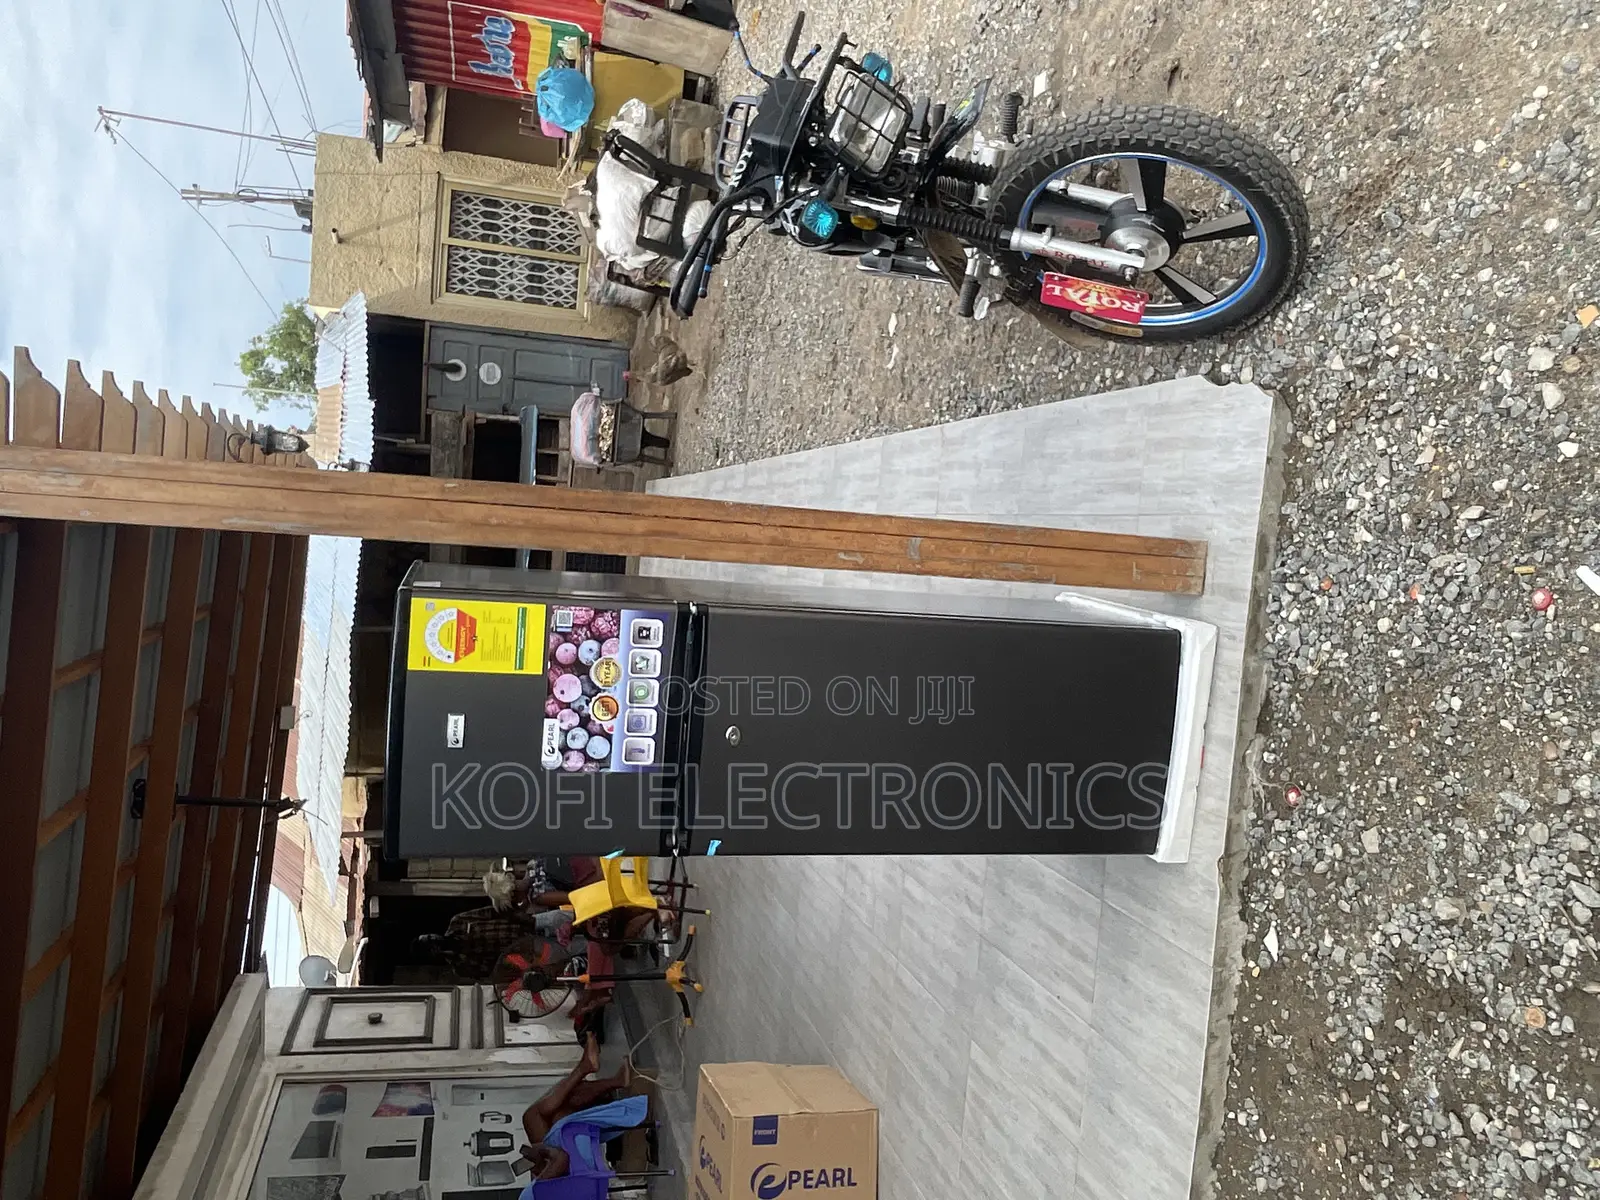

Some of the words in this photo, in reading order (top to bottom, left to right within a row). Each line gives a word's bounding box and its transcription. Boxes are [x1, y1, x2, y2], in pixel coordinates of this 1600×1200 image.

[1045, 284, 1145, 313] ROYAL
[604, 660, 612, 679] YEAR
[787, 1167, 858, 1190] PEARL
